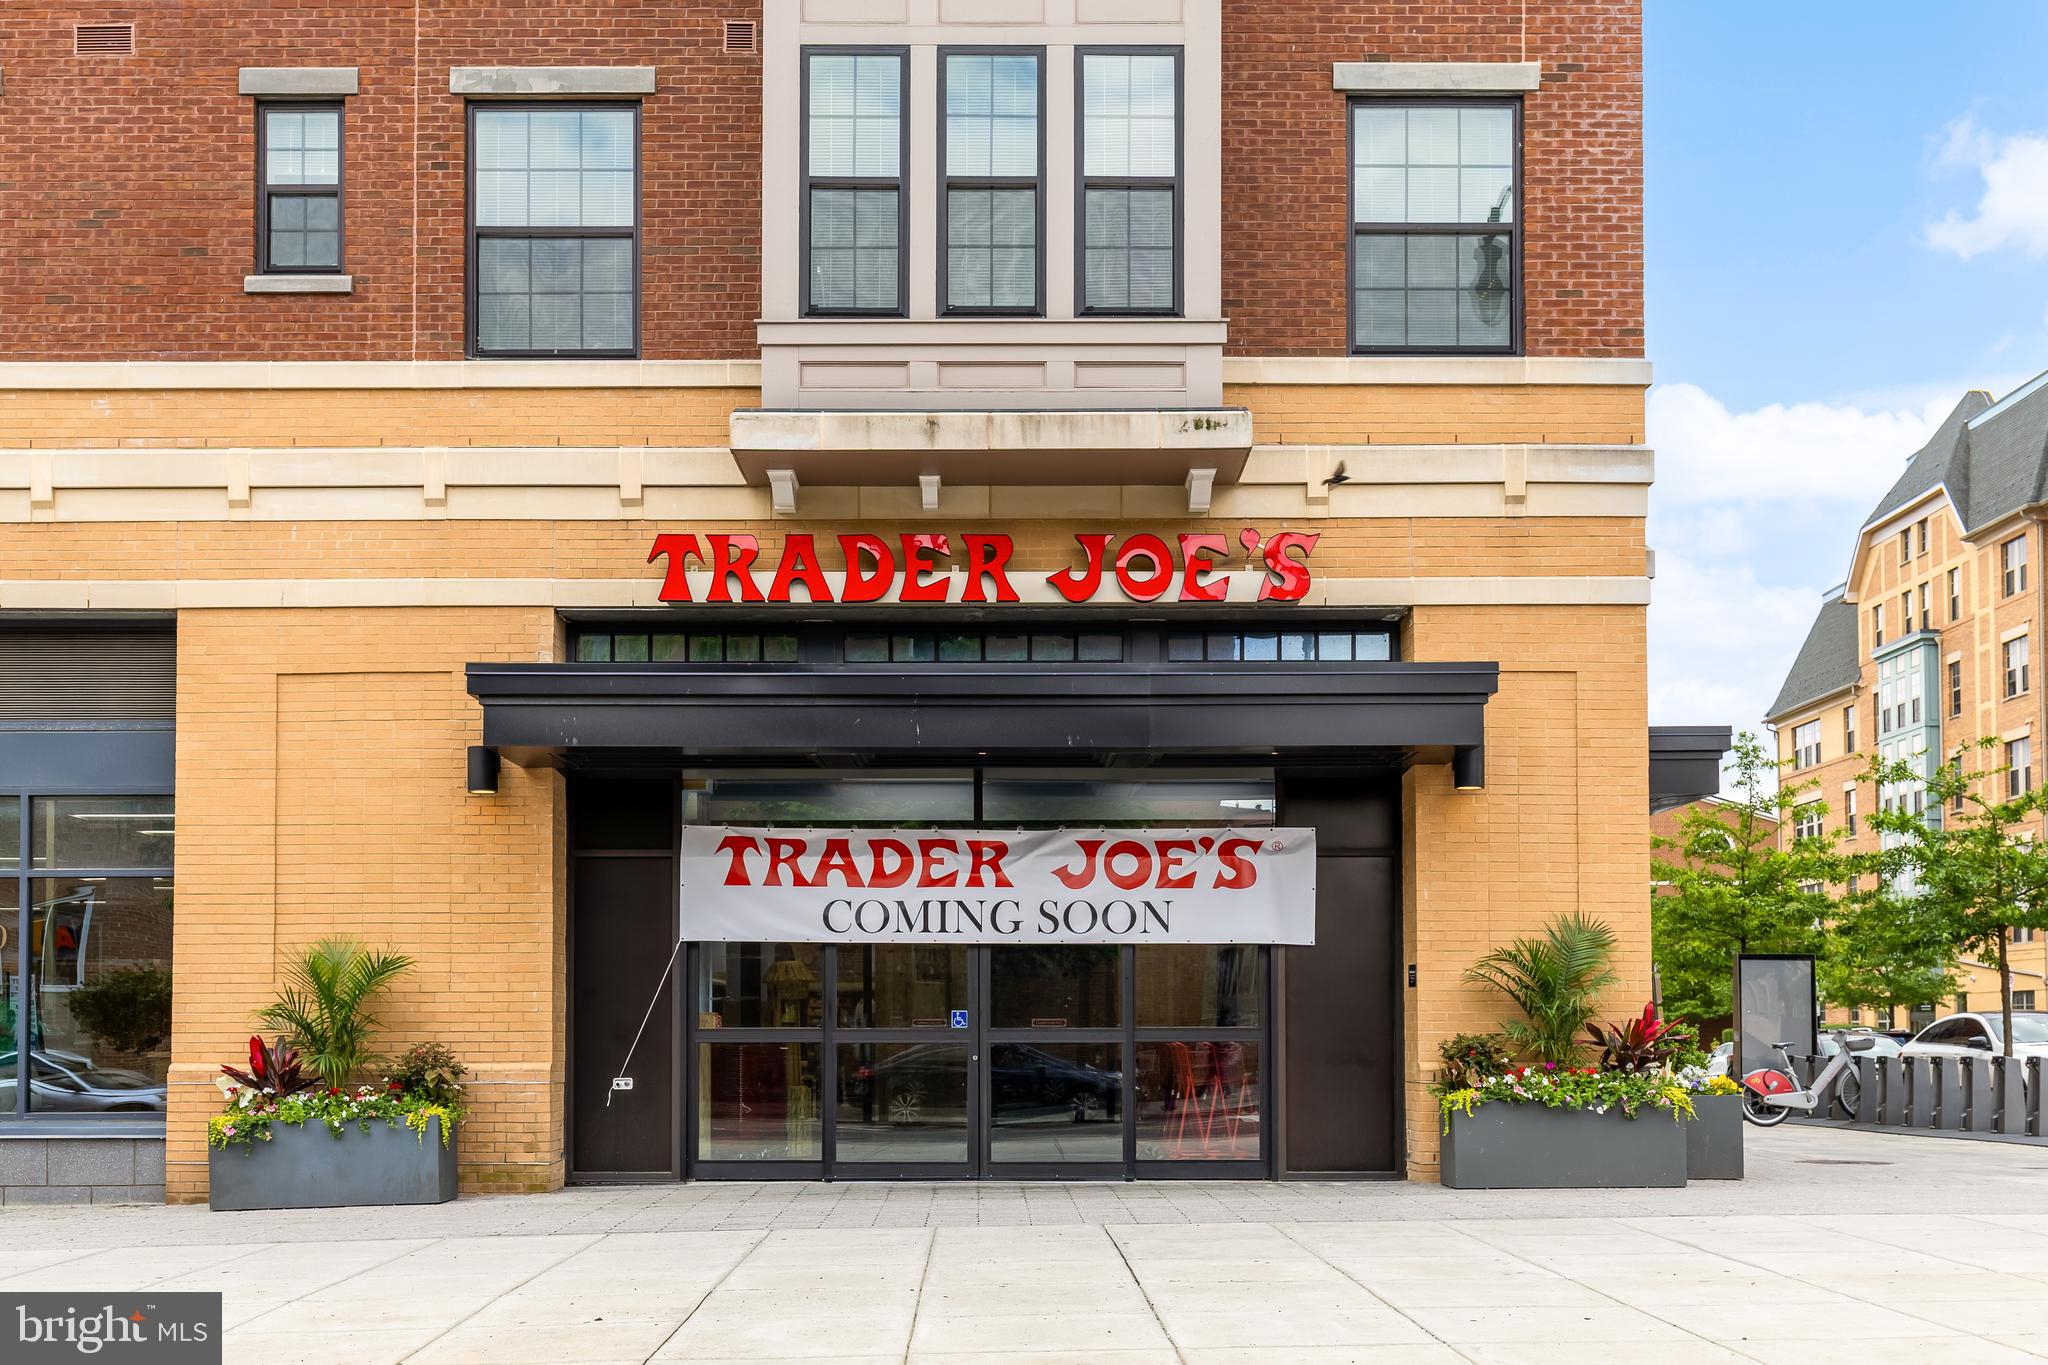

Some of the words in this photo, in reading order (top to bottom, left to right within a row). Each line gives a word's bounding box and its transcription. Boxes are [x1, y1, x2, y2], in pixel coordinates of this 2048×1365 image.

[647, 532, 1021, 603] TRADER
[1045, 527, 1321, 603] JOE'S
[713, 835, 1015, 889] TRADER
[822, 899, 1025, 935] COMING
[1036, 899, 1175, 935] SOON
